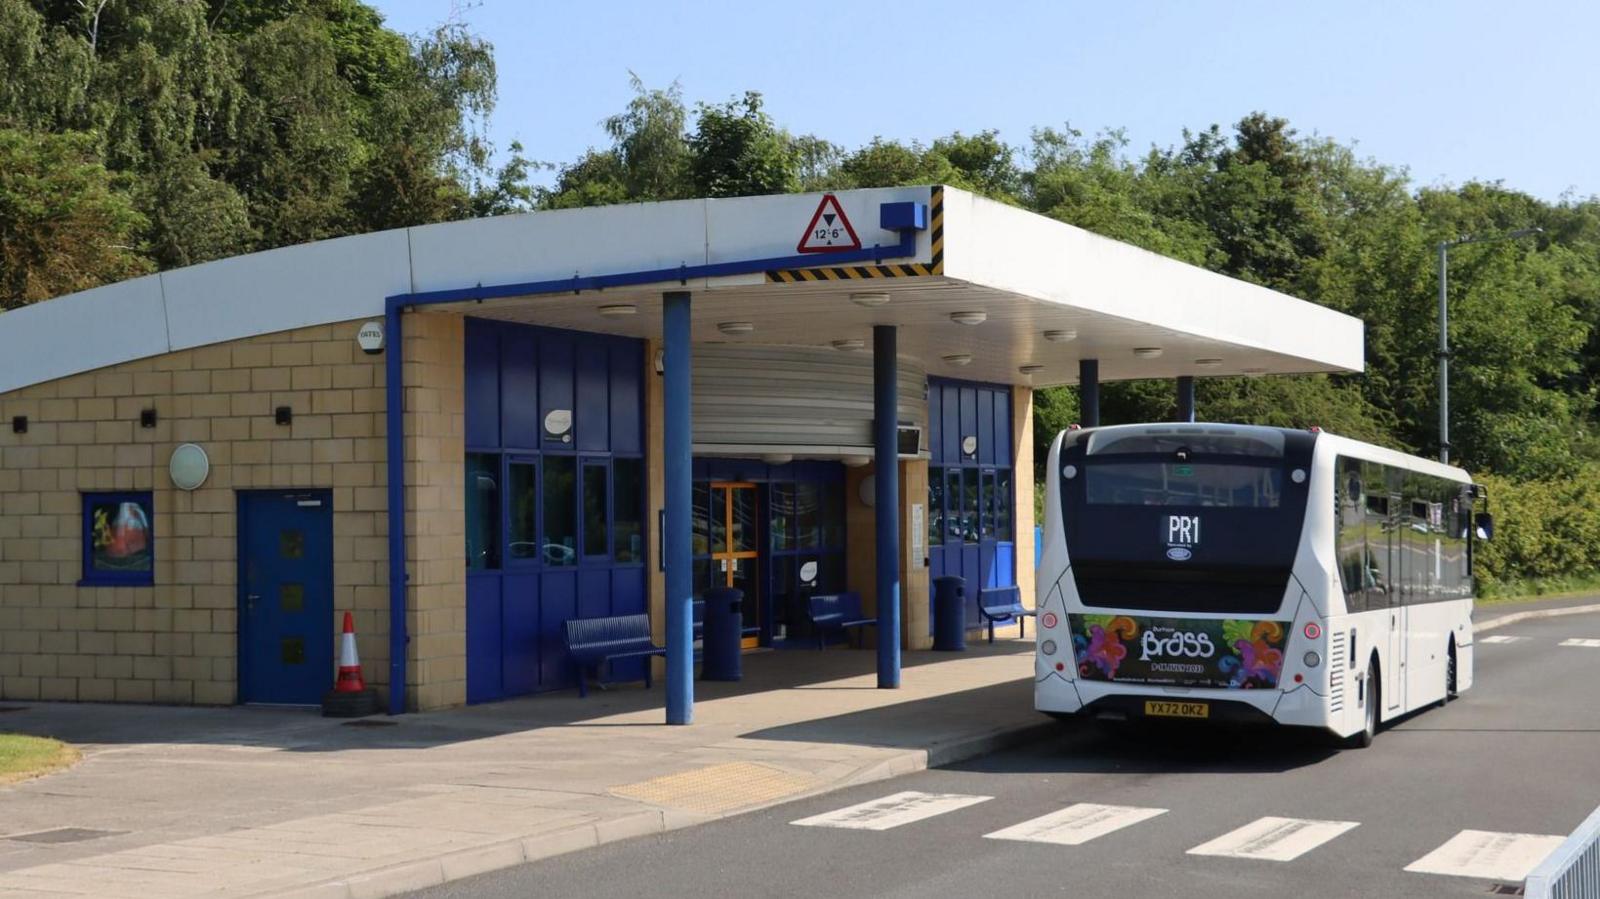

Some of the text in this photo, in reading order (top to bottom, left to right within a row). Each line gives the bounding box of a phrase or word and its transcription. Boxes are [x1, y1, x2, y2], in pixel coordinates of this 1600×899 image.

[1169, 515, 1199, 544] PR1
[1150, 702, 1204, 716] YX72 OKZ
